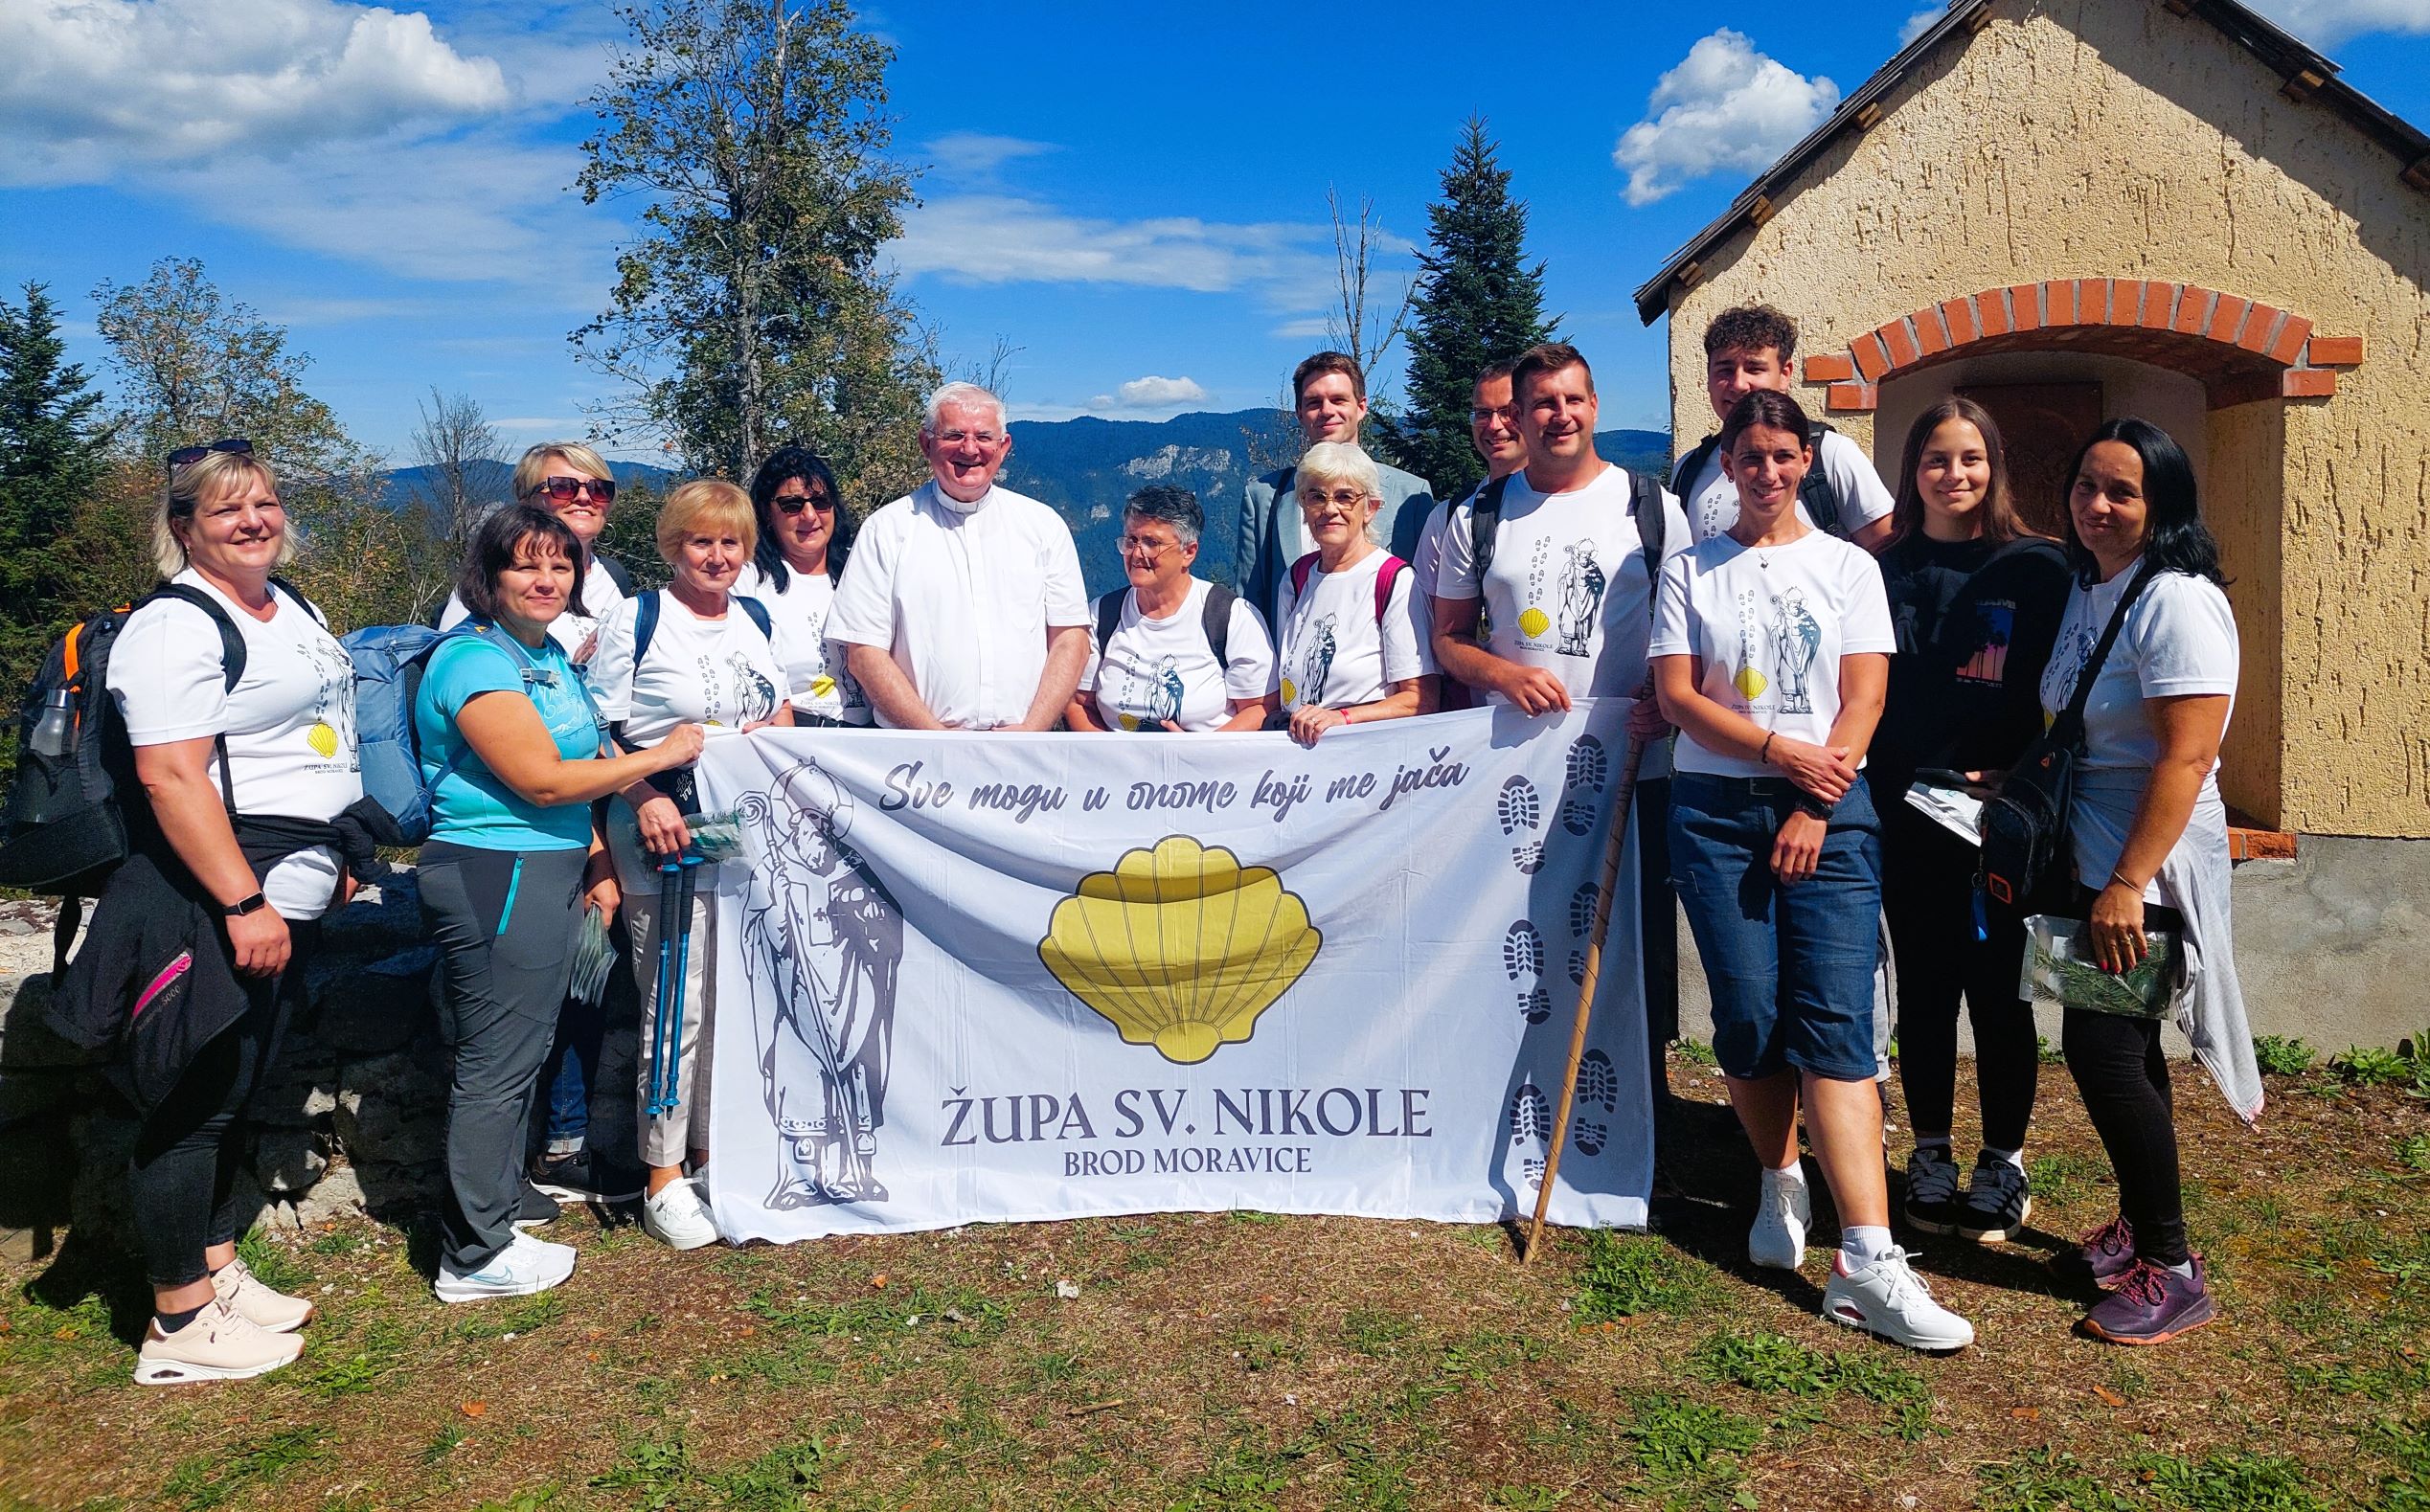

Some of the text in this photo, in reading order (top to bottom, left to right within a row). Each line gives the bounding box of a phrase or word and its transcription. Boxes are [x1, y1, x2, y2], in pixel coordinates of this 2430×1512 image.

[878, 745, 1471, 824] Sve mogu u onome koji me jača
[941, 1085, 1433, 1147] ŽUPA SV. NIKOLE
[1064, 1146, 1312, 1177] BROD MORAVICE
